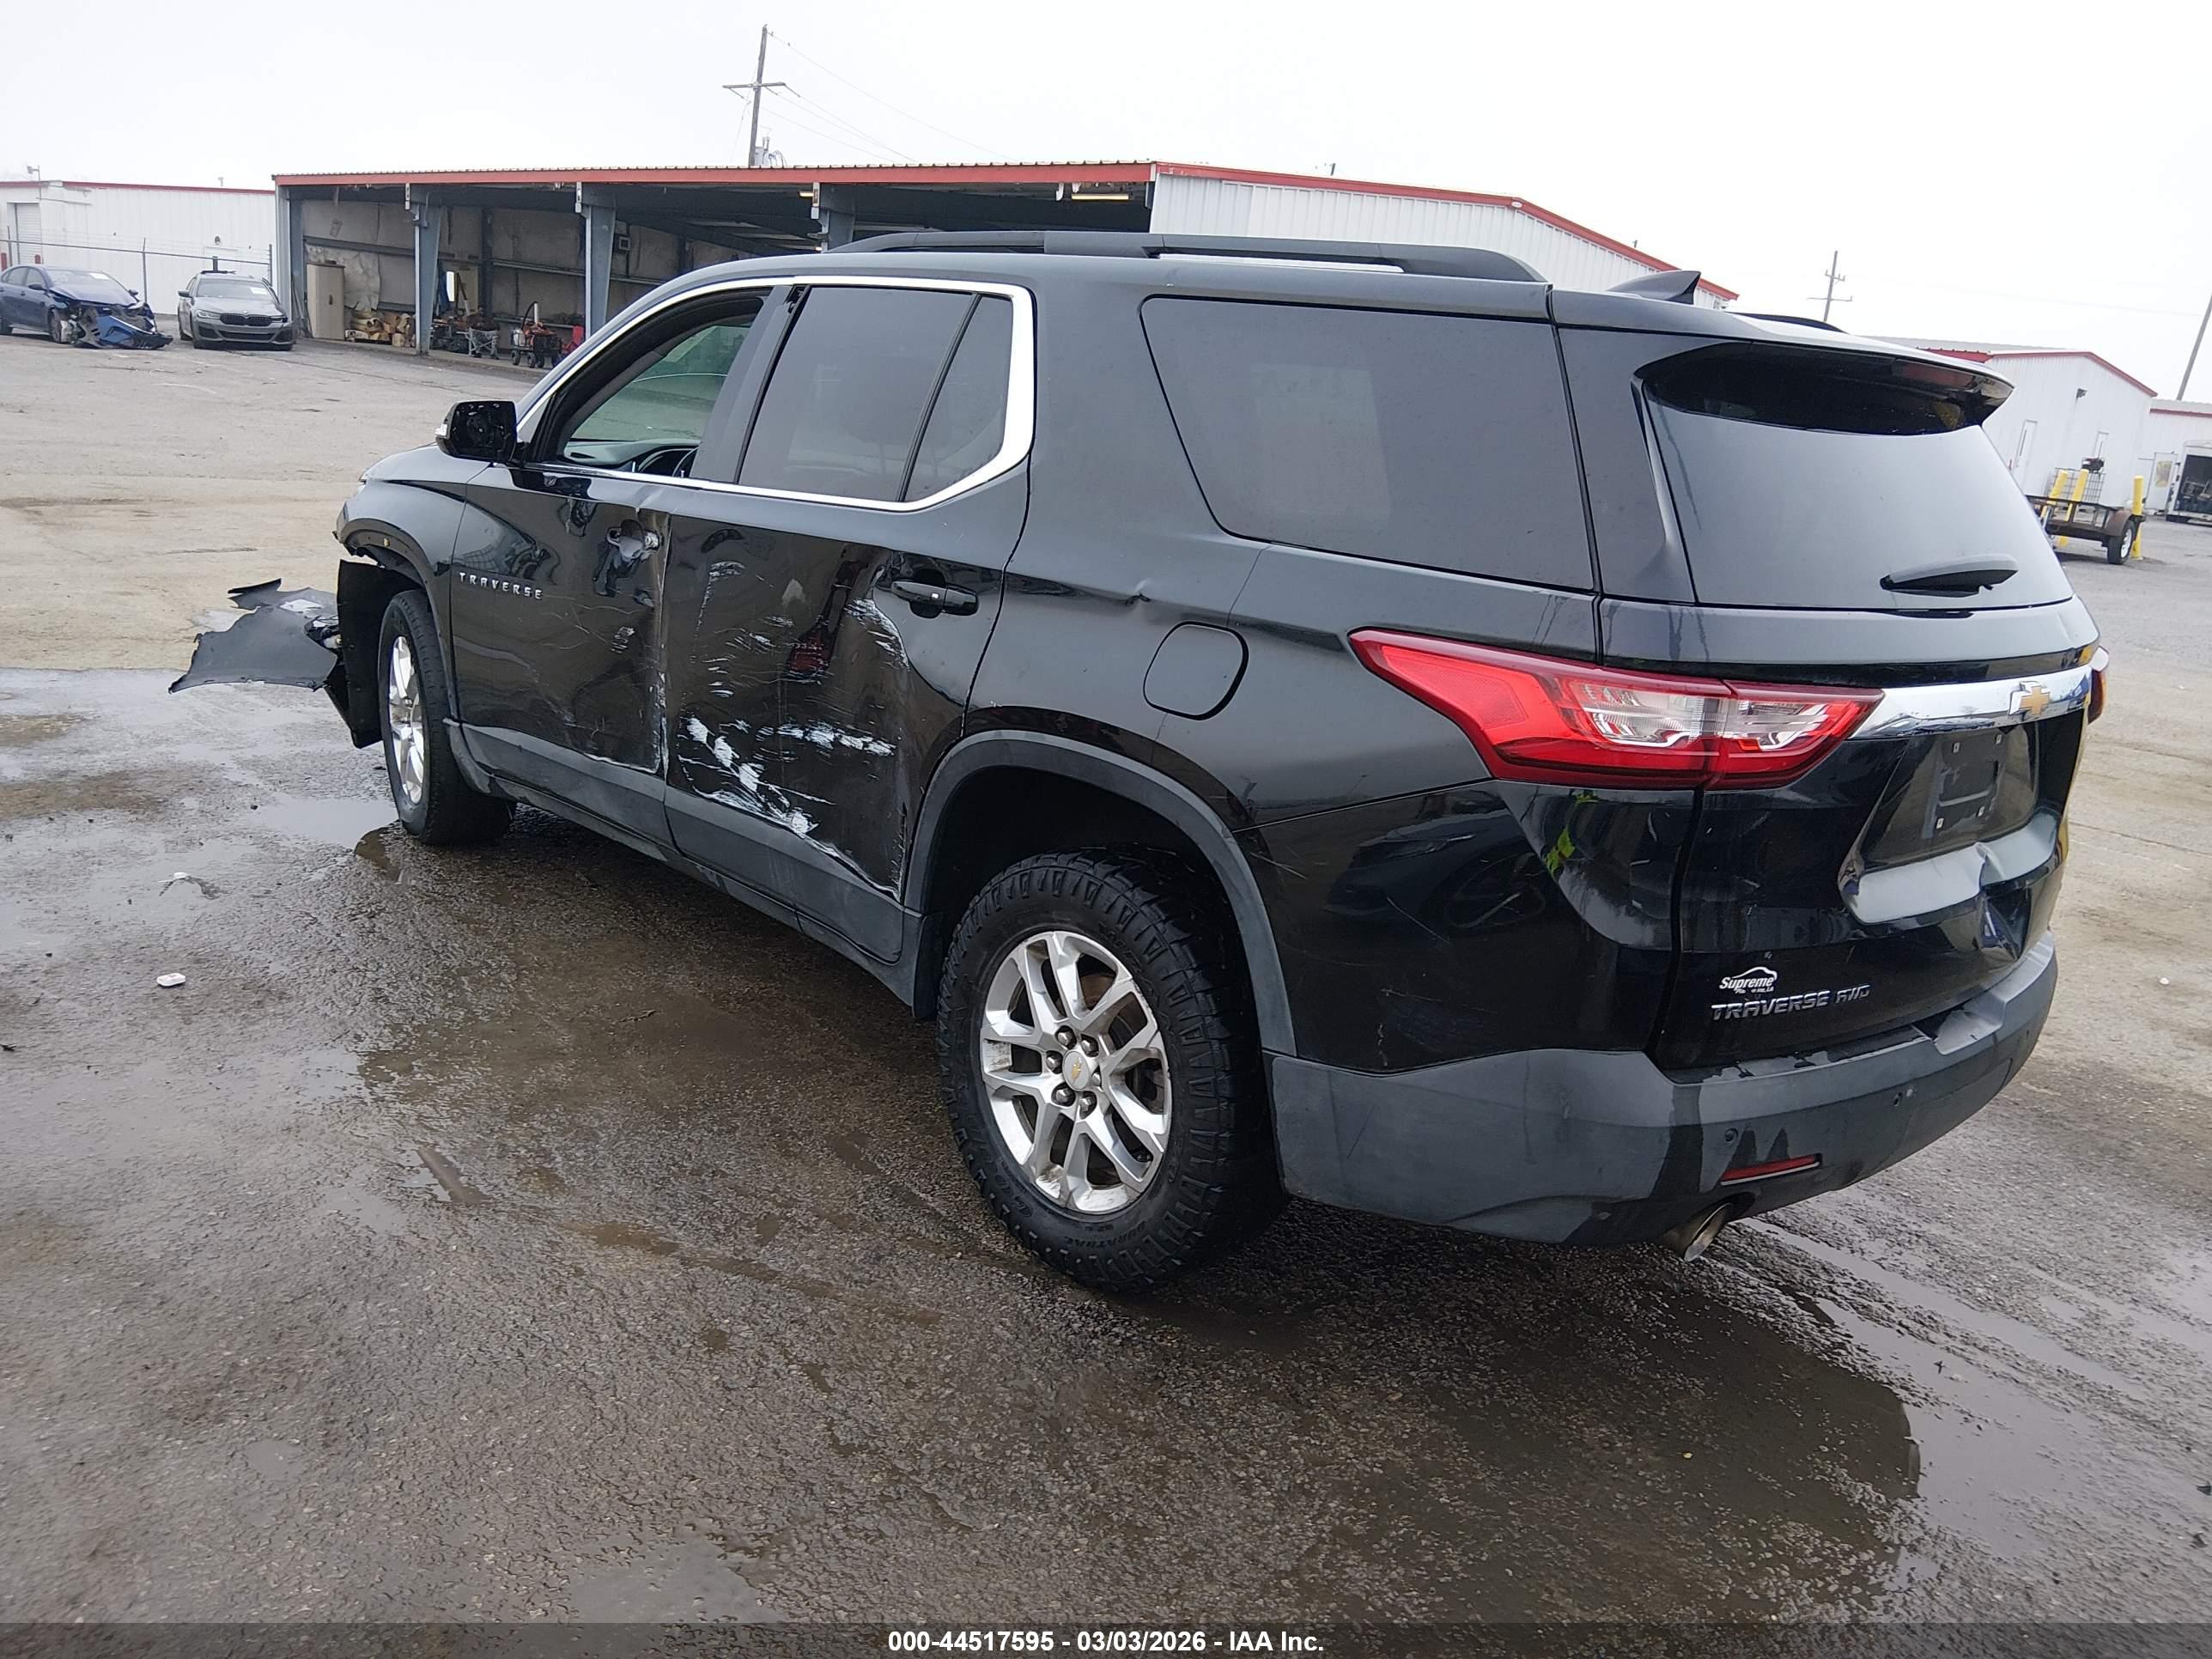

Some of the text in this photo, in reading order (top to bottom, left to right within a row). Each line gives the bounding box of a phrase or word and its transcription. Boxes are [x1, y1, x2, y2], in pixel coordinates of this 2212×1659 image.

[459, 572, 544, 599] TRAVERSE
[1719, 976, 1775, 991] Supreme
[1711, 985, 1870, 1020] TRAVERSE AWD
